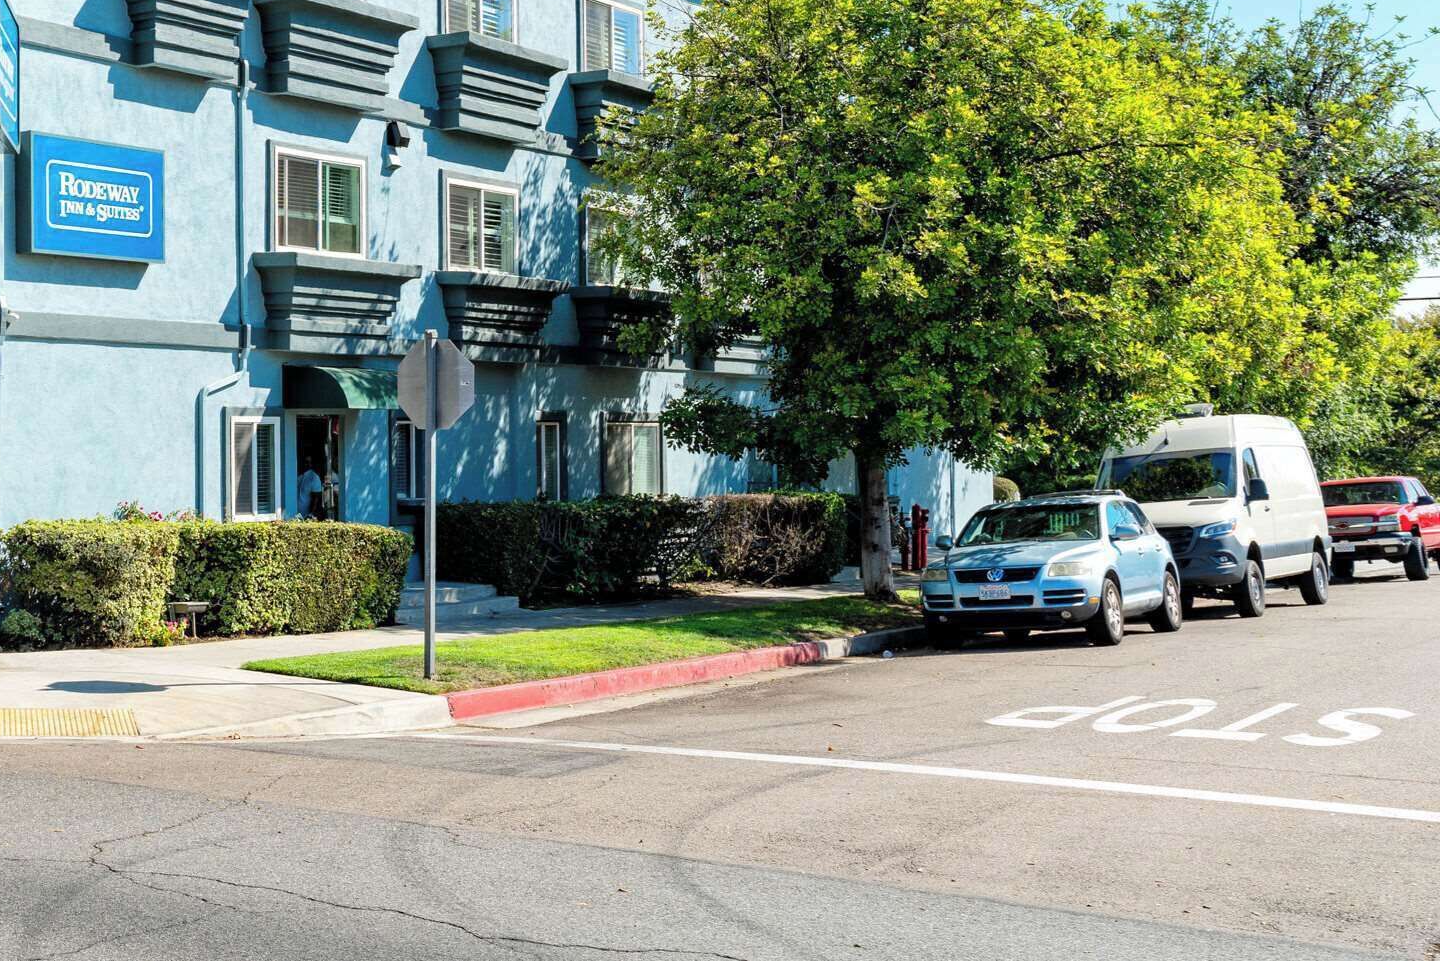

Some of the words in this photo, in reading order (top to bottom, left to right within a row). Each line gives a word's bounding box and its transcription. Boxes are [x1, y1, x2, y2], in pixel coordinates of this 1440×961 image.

[58, 171, 140, 204] RODEWAY
[59, 199, 84, 217] INN
[85, 203, 96, 216] &
[984, 695, 1417, 747] STOP
